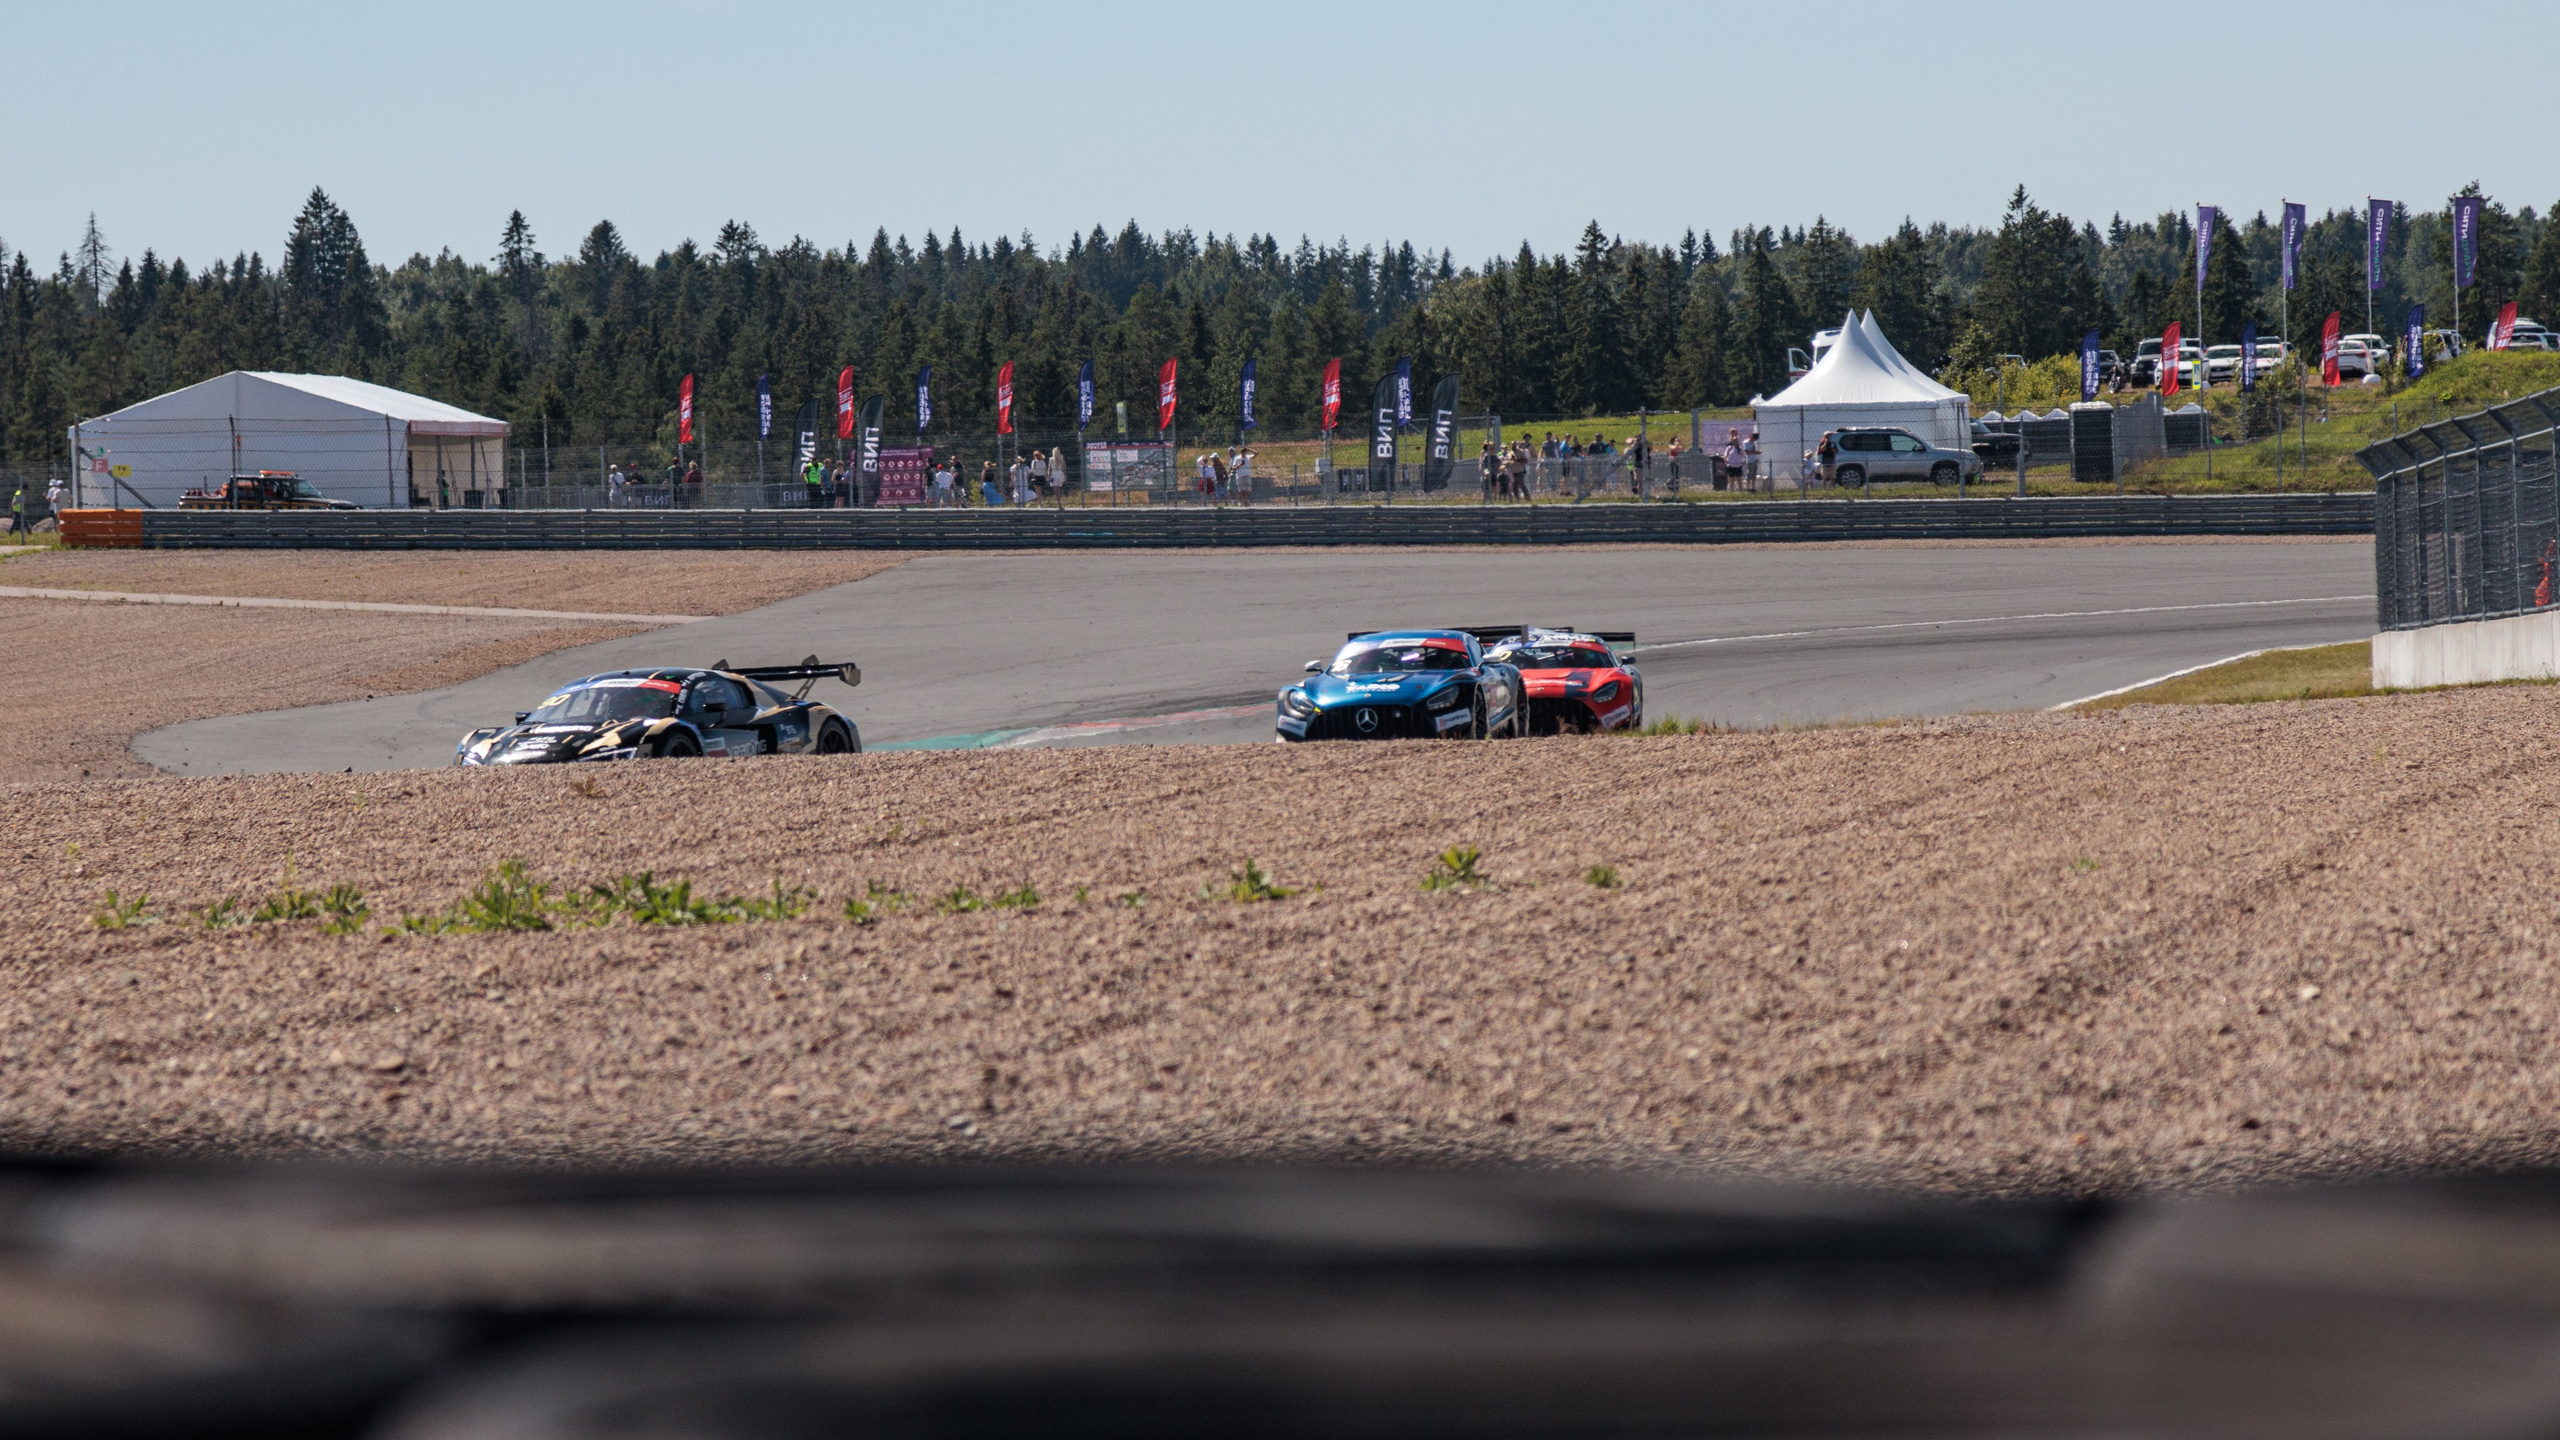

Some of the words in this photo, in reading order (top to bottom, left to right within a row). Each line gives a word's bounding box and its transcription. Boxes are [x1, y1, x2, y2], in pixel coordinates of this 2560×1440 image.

[862, 427, 880, 473] ВИП
[1376, 408, 1394, 458] ВИП
[1434, 409, 1452, 459] ВИП
[95, 460, 103, 471] F
[537, 693, 572, 710] 90
